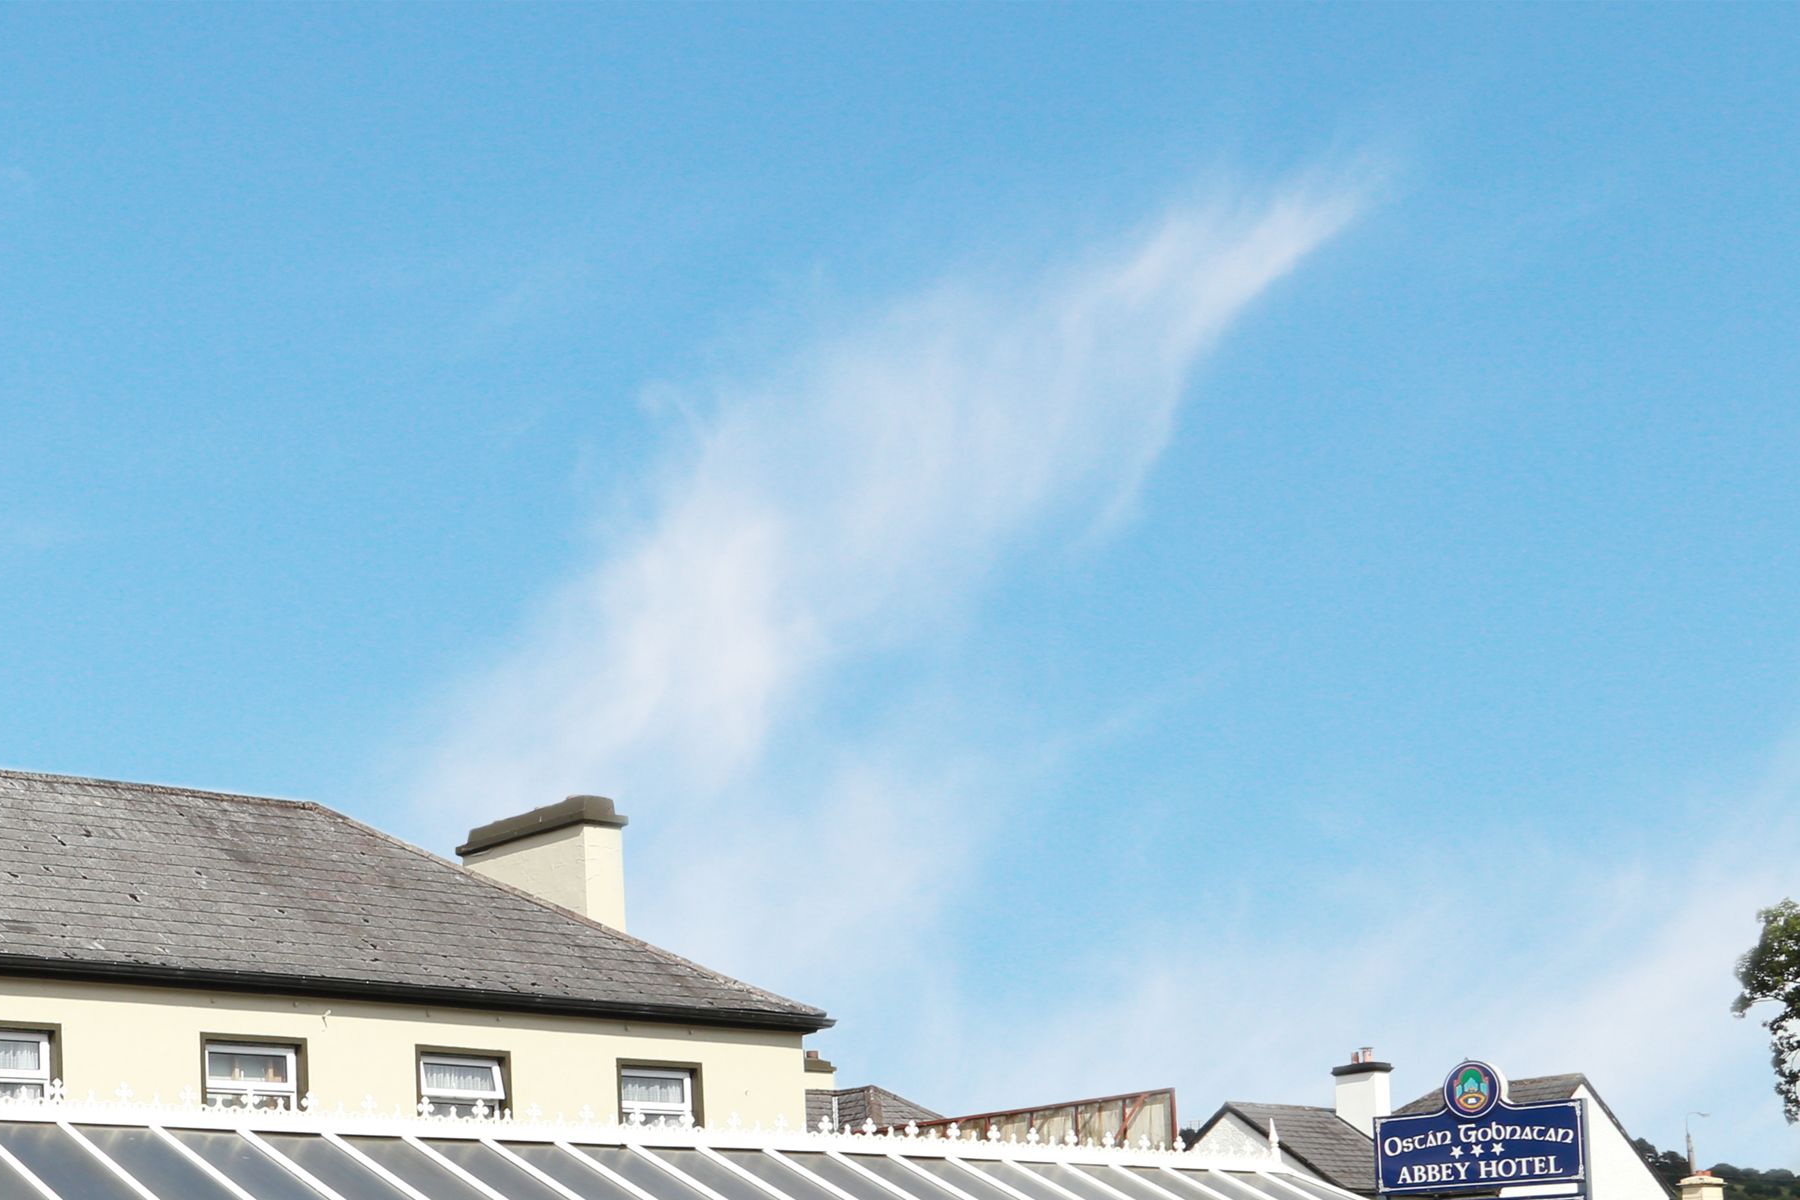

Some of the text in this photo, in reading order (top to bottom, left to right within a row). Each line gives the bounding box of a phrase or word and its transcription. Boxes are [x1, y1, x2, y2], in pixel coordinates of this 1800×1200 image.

[1384, 1121, 1574, 1157] Ostán Gobnatan
[1397, 1156, 1563, 1185] ABBEY HOTEL
